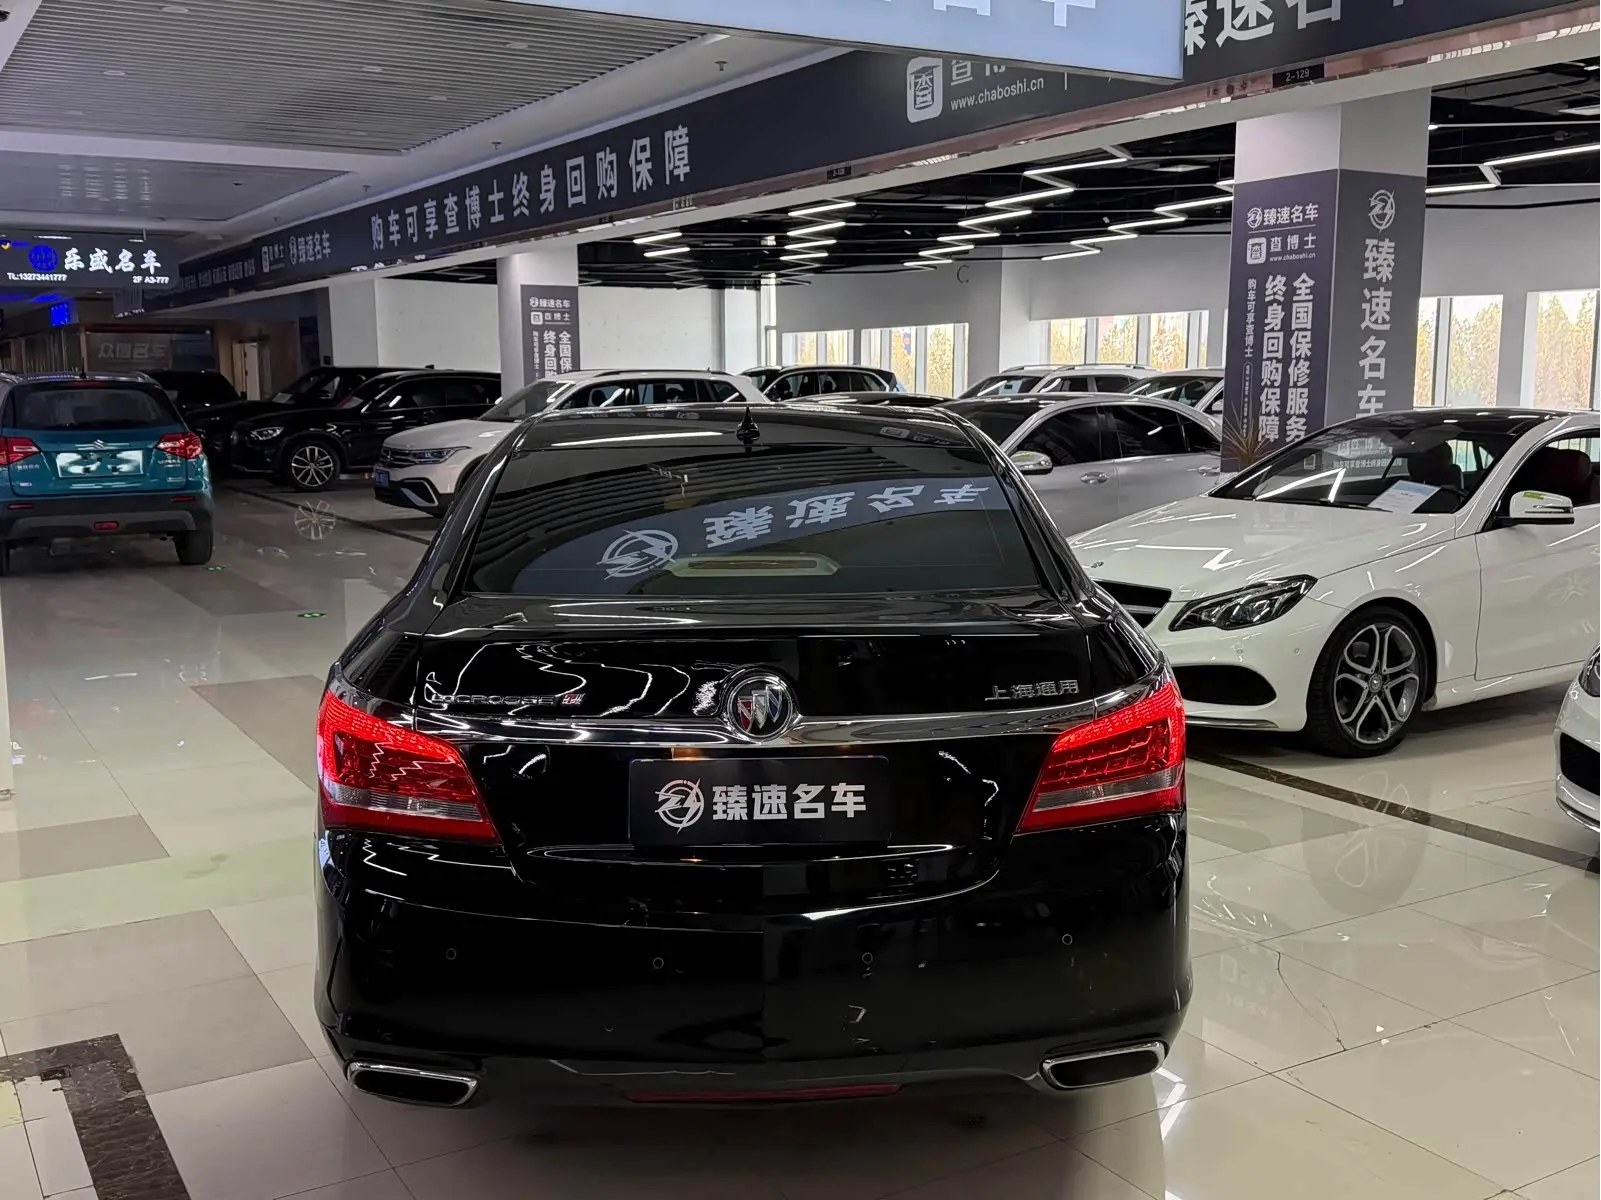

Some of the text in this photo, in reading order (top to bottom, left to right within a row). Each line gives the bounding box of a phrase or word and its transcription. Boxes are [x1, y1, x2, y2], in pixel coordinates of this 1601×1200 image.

[951, 77, 1044, 111] www.chaboshi.cn
[1286, 69, 1310, 82] 2-129
[371, 125, 691, 250] 购车可享查博士终身回购保障
[1263, 203, 1319, 226] 臻速名车
[1355, 237, 1395, 418] 臻速名车
[1258, 274, 1287, 442] 终身回购保障
[1285, 272, 1315, 442] 全国保修服务
[984, 680, 1080, 701] 上海通用
[712, 783, 867, 821] 臻速名车
